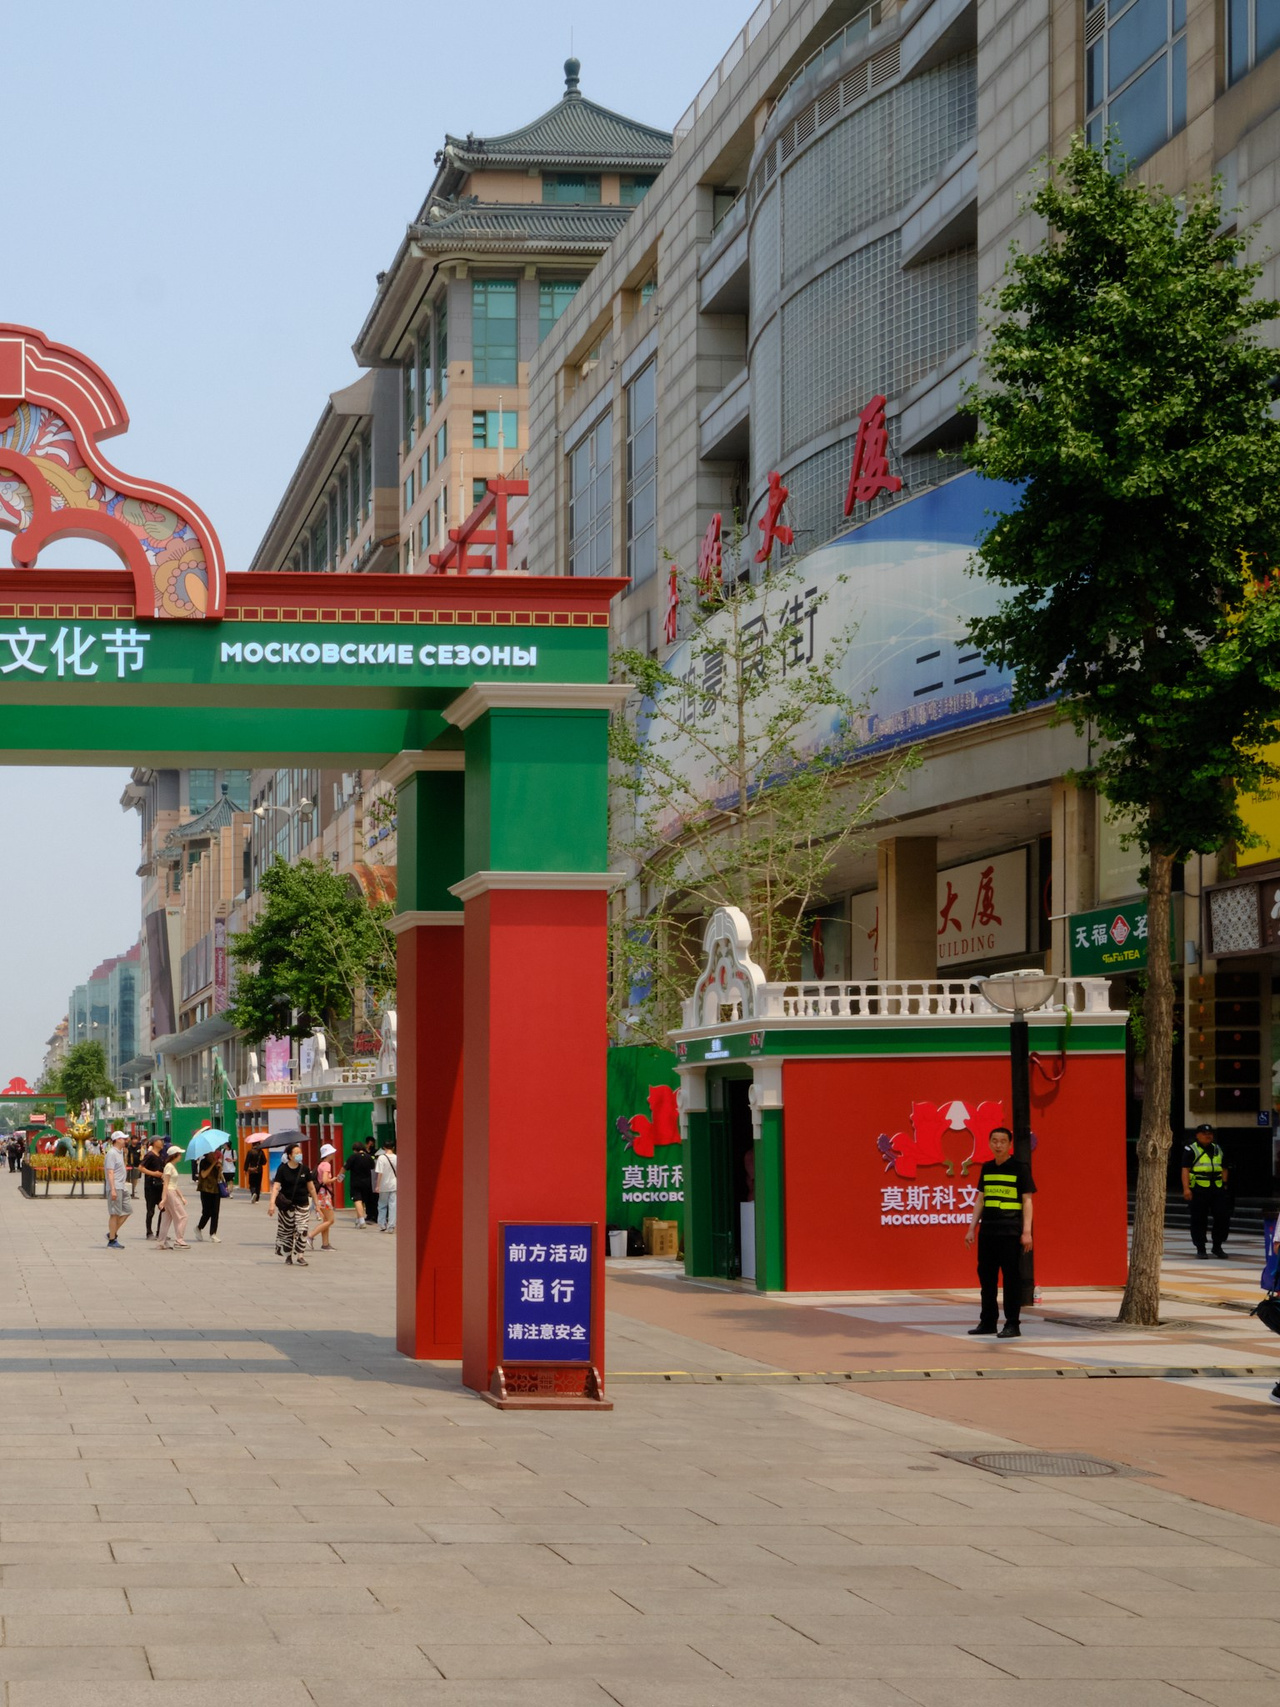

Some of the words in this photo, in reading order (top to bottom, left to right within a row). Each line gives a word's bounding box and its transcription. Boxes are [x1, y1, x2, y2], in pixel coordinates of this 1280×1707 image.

[220, 642, 414, 665] МОСКОВСКИЕ
[419, 644, 537, 666] СЕЗОНЫ
[1075, 923, 1108, 948] 天福
[881, 1212, 973, 1226] МОСКОВСКИЕ
[509, 1243, 588, 1263] 前方活动
[521, 1279, 575, 1303] 通行
[508, 1323, 587, 1341] 请注意安全
